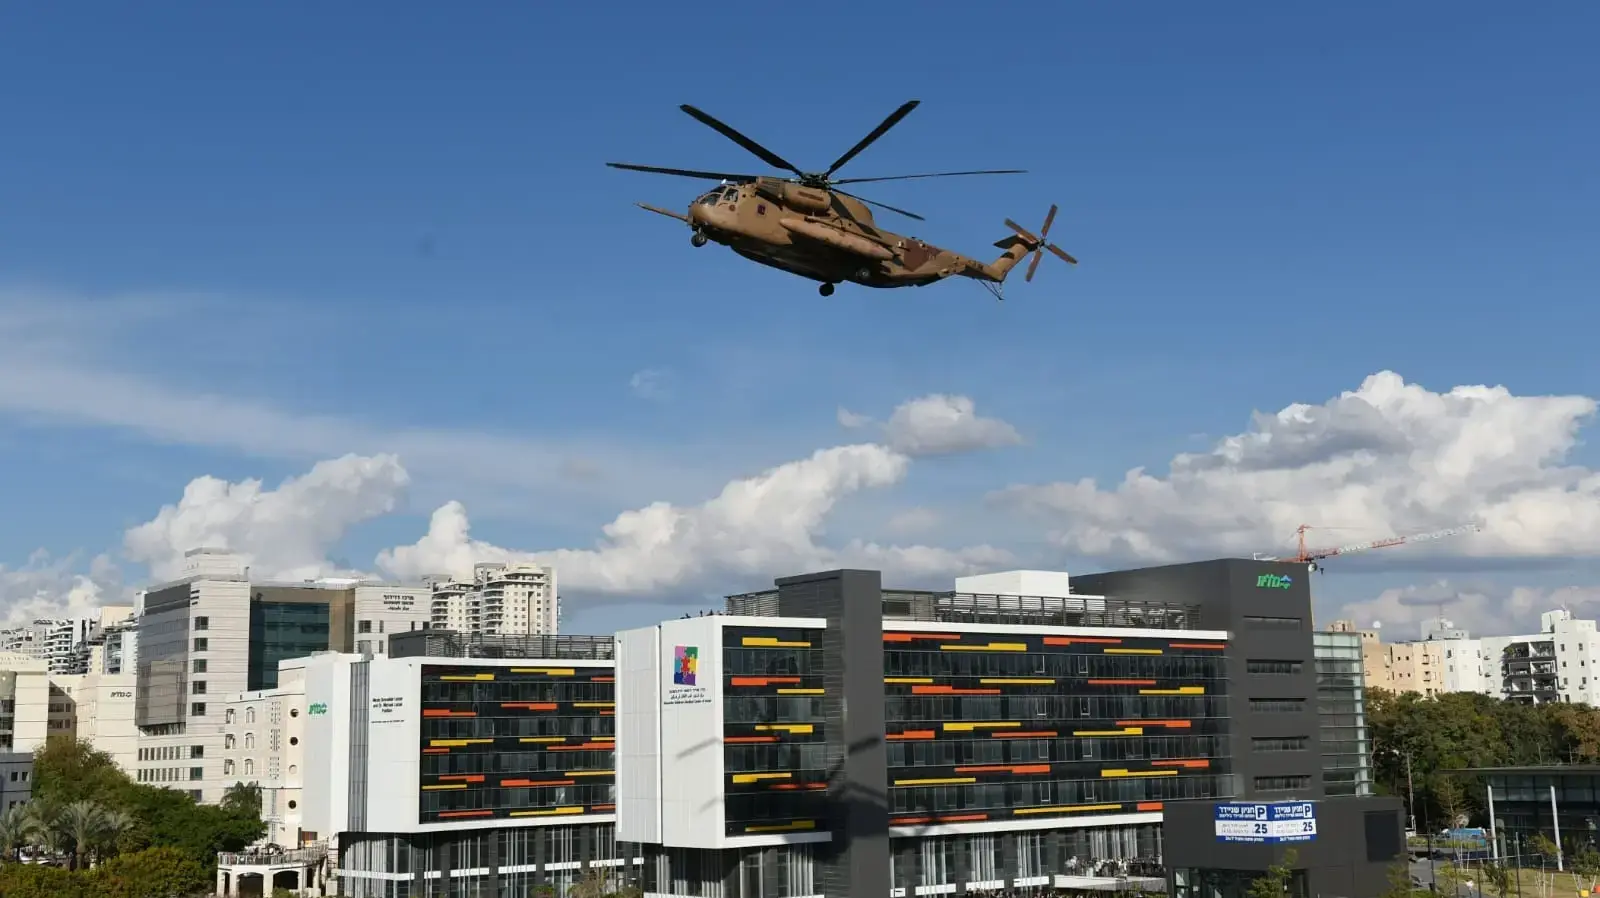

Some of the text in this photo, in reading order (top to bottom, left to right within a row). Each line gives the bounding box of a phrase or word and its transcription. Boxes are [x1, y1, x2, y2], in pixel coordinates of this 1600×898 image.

[1257, 807, 1265, 818] P
[1304, 805, 1311, 817] P
[1254, 823, 1268, 834] 25
[1303, 822, 1313, 832] 25
